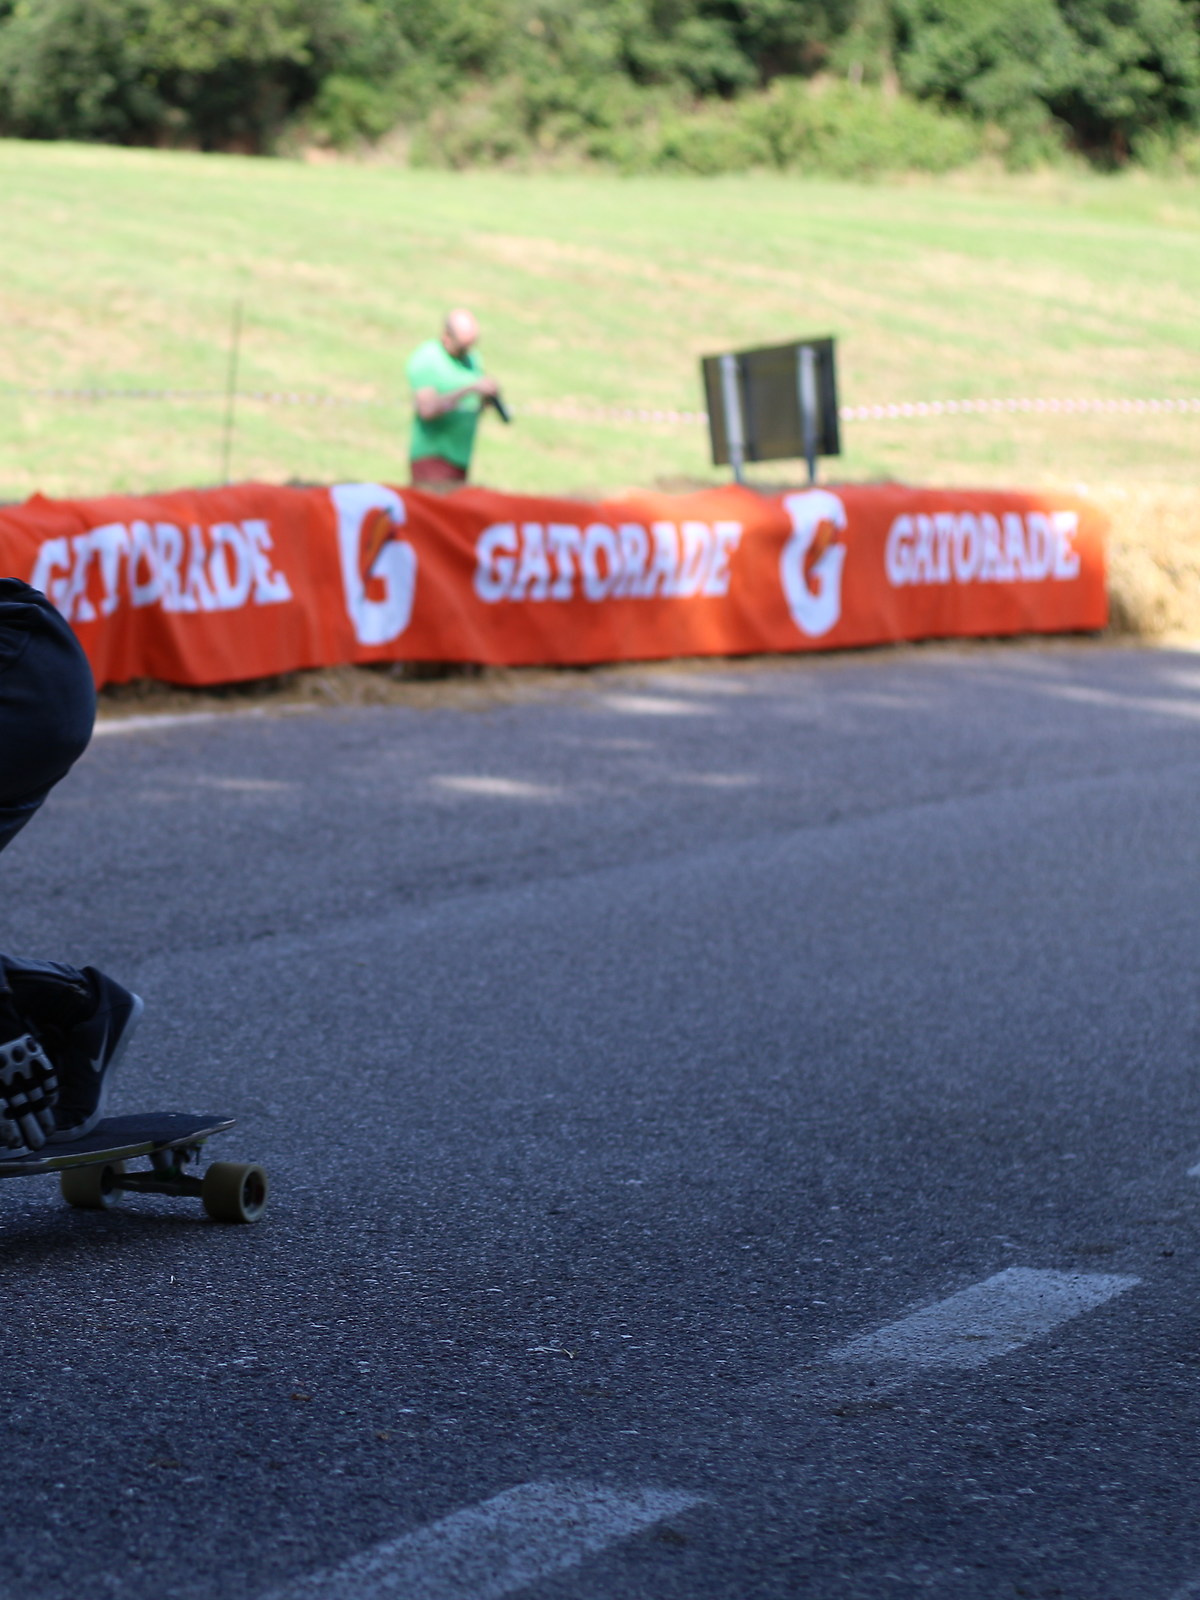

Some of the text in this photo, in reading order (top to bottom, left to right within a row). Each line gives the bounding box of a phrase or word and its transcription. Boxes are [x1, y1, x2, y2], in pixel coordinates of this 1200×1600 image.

[30, 519, 293, 623] GATORADE
[329, 483, 417, 646] G
[473, 520, 743, 603] GATORADE
[779, 489, 847, 637] G
[884, 511, 1082, 588] GATORADE
